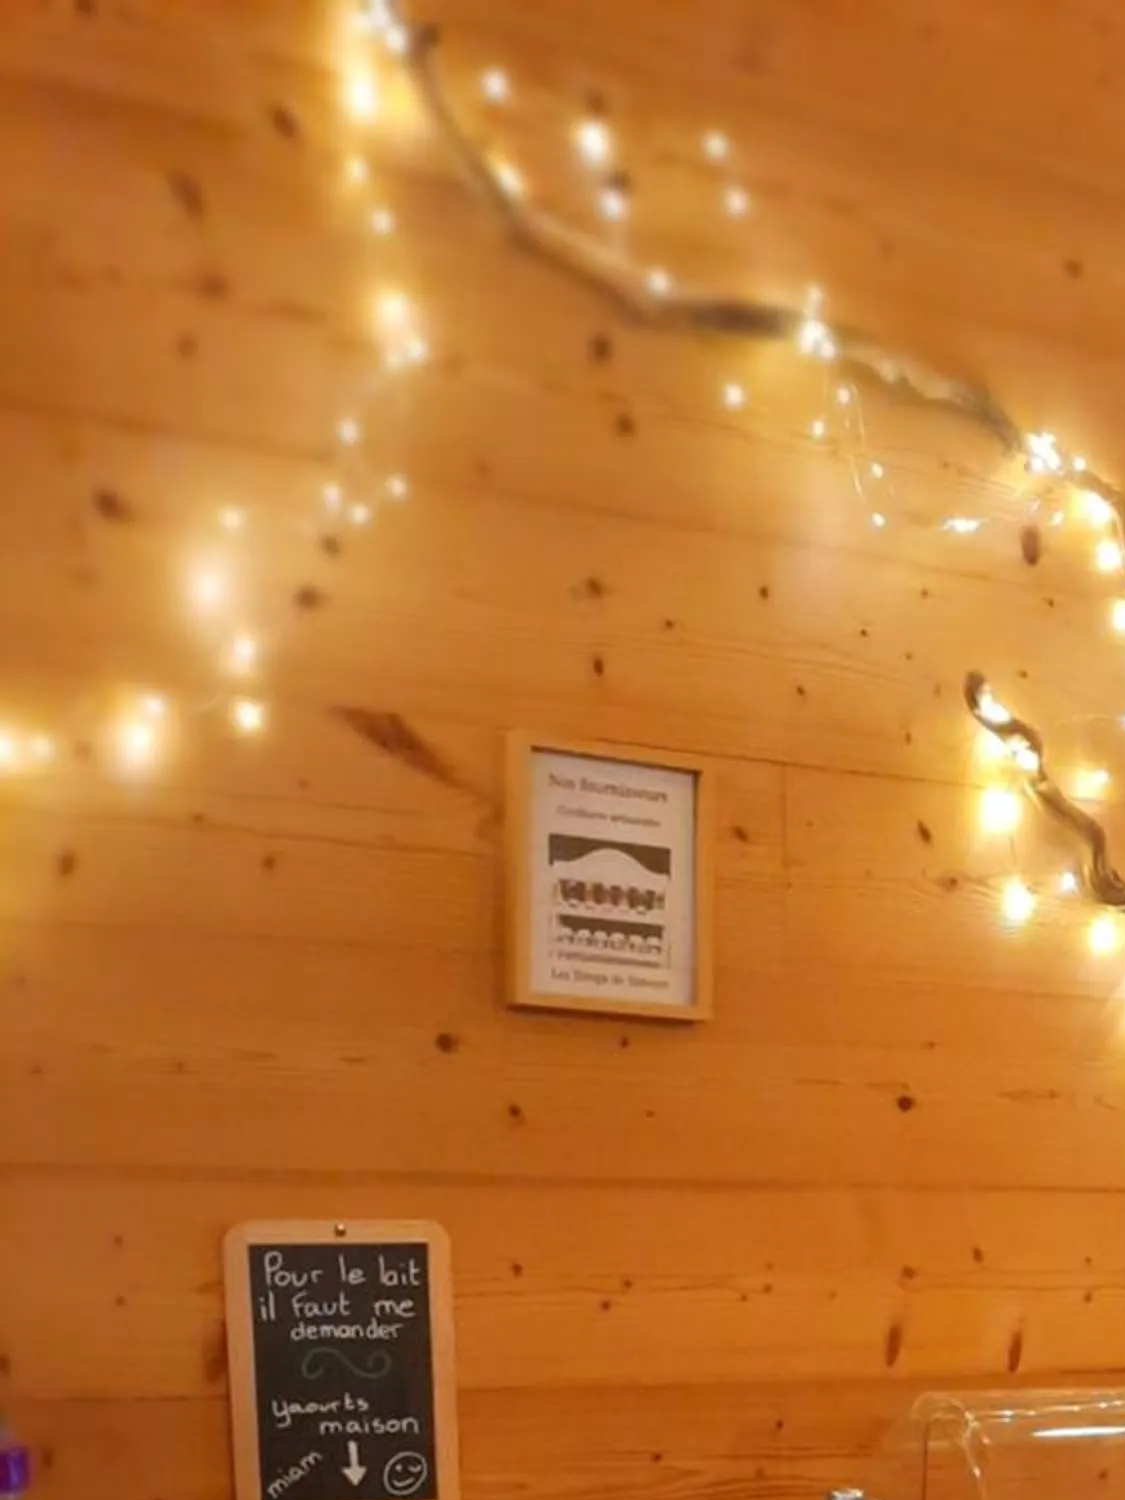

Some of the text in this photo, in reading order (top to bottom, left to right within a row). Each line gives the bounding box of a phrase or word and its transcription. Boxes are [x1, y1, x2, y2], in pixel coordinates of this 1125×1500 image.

[264, 1251, 421, 1287] Pour le lait
[258, 1291, 276, 1321] il
[374, 1298, 416, 1318] me
[290, 1318, 404, 1341] demander
[319, 1416, 421, 1435] maison
[266, 1450, 324, 1500] miam
